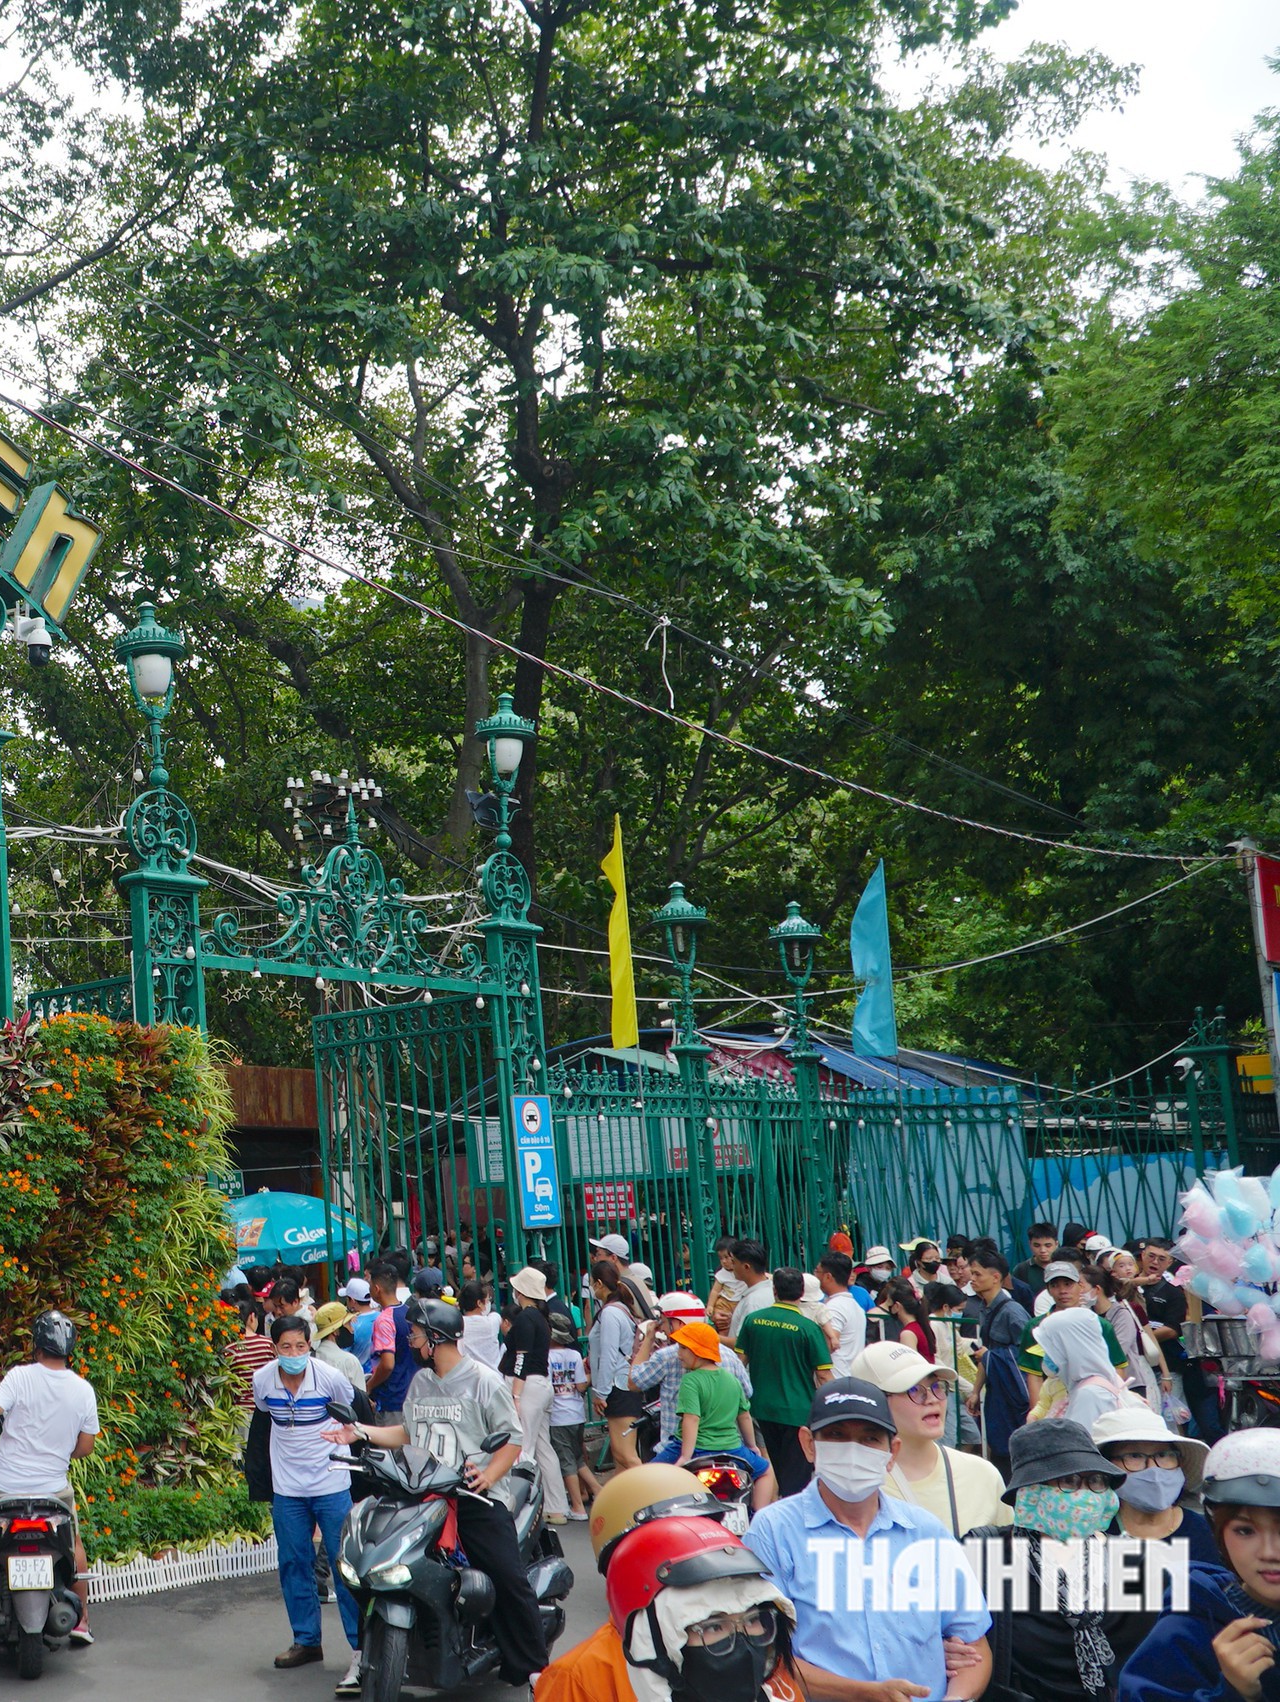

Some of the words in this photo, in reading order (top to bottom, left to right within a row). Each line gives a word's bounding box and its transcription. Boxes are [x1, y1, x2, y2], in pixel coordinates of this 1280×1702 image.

[523, 1152, 542, 1192] P
[534, 1203, 550, 1212] 50m
[301, 1248, 329, 1263] Celan
[753, 1318, 781, 1327] SAIGON
[781, 1322, 799, 1332] ZOO
[415, 1421, 458, 1467] 10
[14, 1558, 47, 1573] 59-F2
